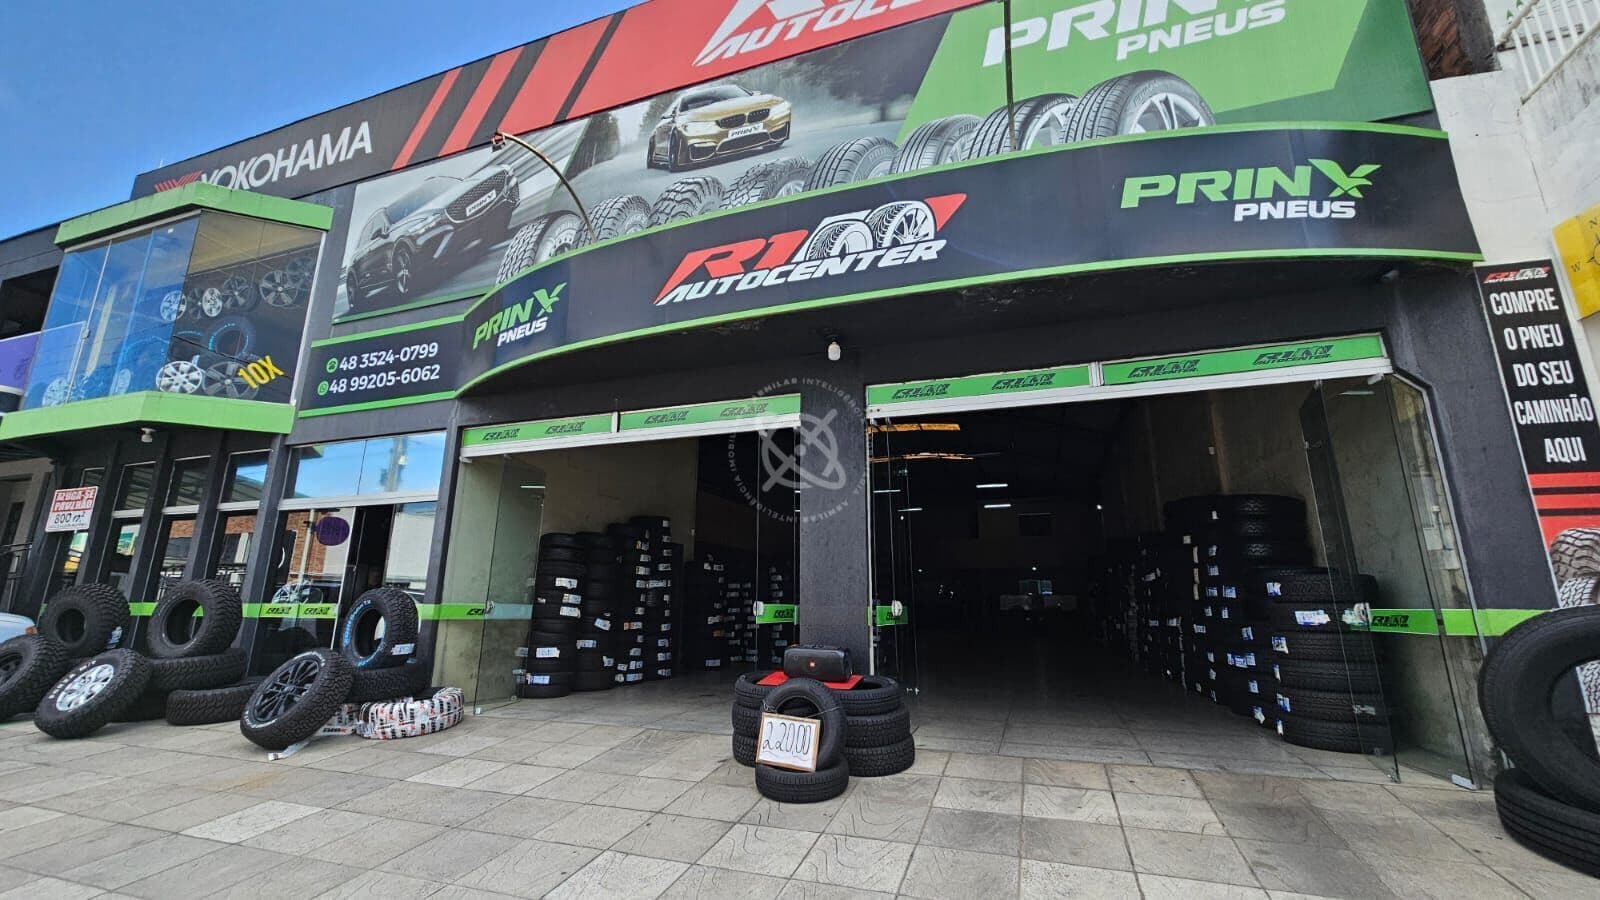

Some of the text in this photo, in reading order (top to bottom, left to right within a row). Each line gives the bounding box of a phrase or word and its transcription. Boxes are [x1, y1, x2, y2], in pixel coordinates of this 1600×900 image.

[982, 0, 1218, 67] PRIN
[1117, 0, 1286, 61] PNEUS
[200, 120, 372, 190] YOKOHAMA
[1120, 158, 1382, 208] PRINX
[1233, 201, 1356, 222] PNEUS
[653, 229, 809, 304] R1
[656, 239, 947, 306] AUTOCENTER
[472, 282, 568, 350] PRINX
[1489, 287, 1559, 316] COMPRE
[497, 316, 548, 347] PNEUS
[1503, 324, 1564, 350] O PNEU
[238, 355, 284, 389] 10X
[339, 342, 439, 371] 48 3524-0799
[329, 364, 441, 394] 48 99205-6062
[1513, 360, 1574, 387] DO SEU
[1514, 394, 1594, 425] CAMINHÃO
[1544, 437, 1587, 463] AQUI
